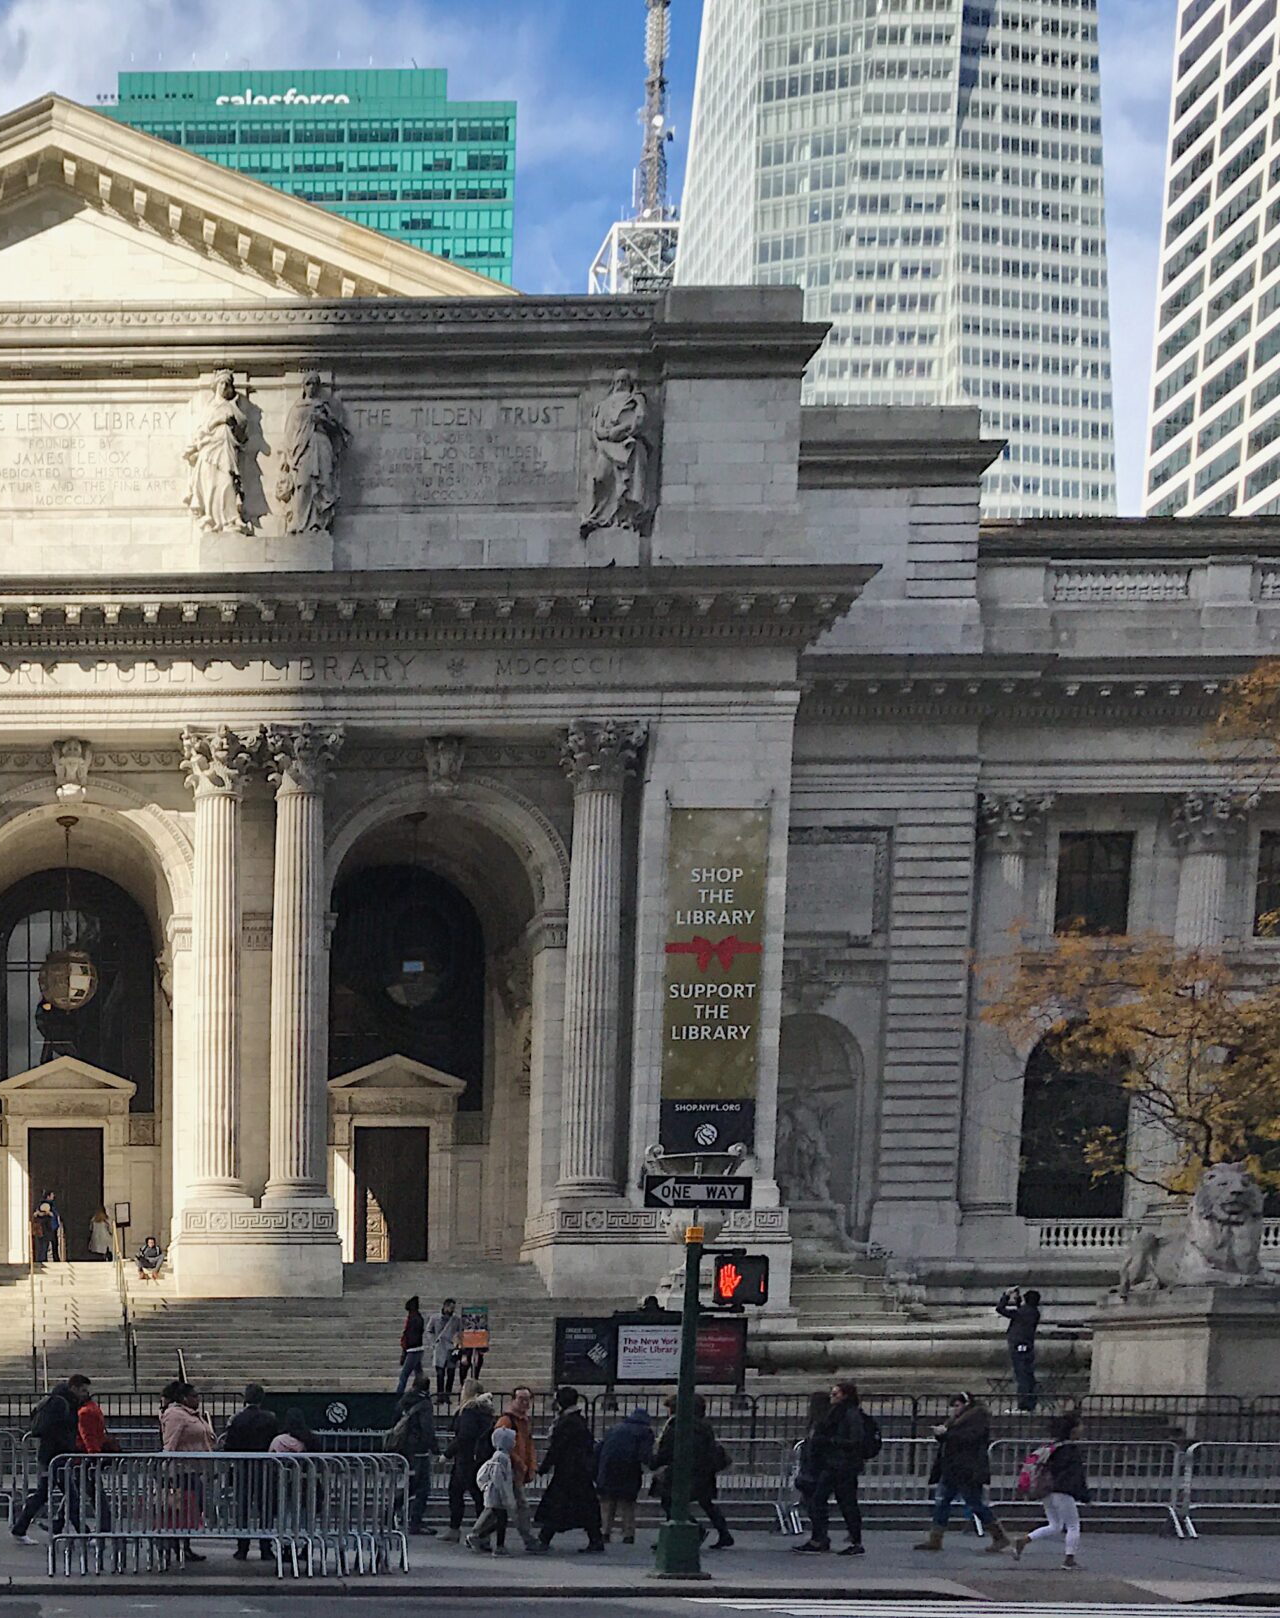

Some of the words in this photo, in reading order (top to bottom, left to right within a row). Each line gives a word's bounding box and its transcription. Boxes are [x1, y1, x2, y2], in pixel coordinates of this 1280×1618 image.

[215, 88, 350, 105] salesforce
[16, 413, 83, 432] LENOX
[93, 411, 177, 432] LIBRARY
[353, 408, 393, 429] THE
[410, 406, 483, 427] TILDEN
[500, 405, 565, 426] TRUST
[28, 438, 86, 450] FOUNDED
[99, 438, 114, 450] BY
[13, 452, 64, 466] JAMES
[77, 451, 131, 465] LENOX
[50, 481, 75, 492] AND
[83, 481, 106, 492] THE
[113, 480, 141, 492] FINE
[146, 480, 177, 491] ARTS
[93, 660, 225, 685] PUBLIC
[260, 656, 417, 683] LIBRARY
[691, 867, 744, 883] SHOP
[698, 889, 734, 904] THE
[676, 909, 756, 926] LIBRARY
[669, 983, 757, 999] SUPPORT
[693, 1004, 729, 1020] THE
[671, 1025, 751, 1041] LIBRARY
[674, 1103, 742, 1112] SHOP.NYPL.ORG
[661, 1184, 691, 1199] ONE
[705, 1184, 739, 1199] WAY
[623, 1337, 639, 1345] The
[640, 1337, 659, 1345] New
[661, 1337, 679, 1345] York
[623, 1345, 648, 1354] Public
[650, 1345, 679, 1355] Library
